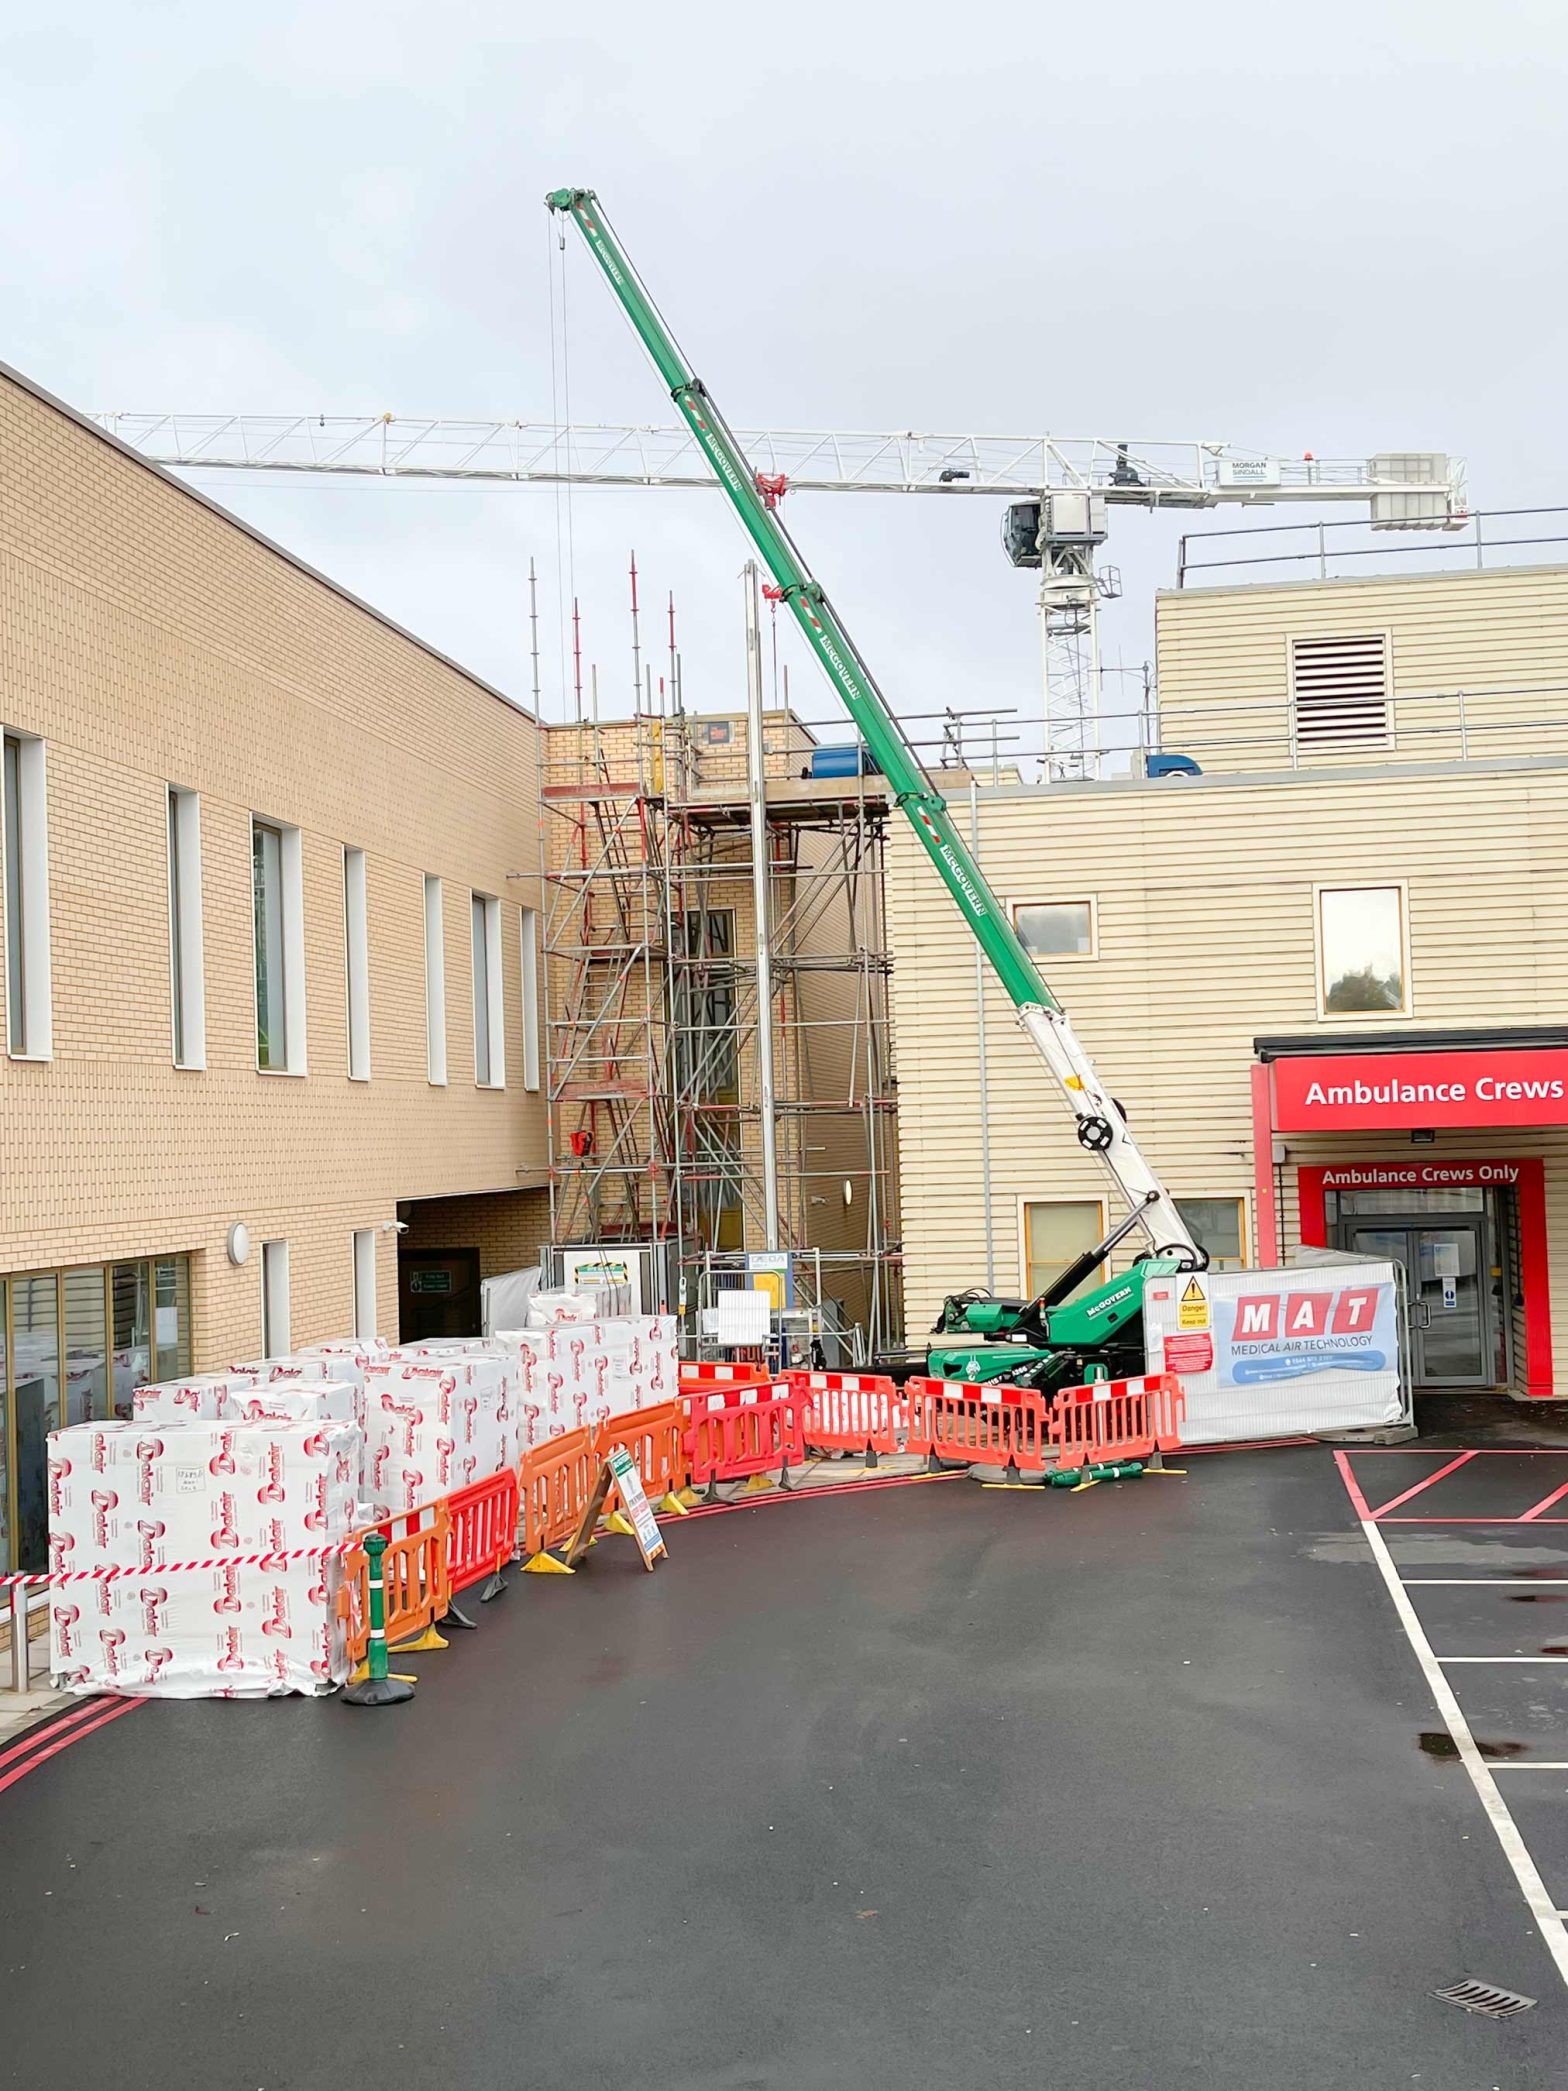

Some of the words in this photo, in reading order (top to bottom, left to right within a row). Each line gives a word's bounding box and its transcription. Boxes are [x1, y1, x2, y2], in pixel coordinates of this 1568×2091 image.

[940, 844, 988, 917] McGOVERN
[1304, 1079, 1466, 1105] Ambulance
[1475, 1077, 1565, 1101] Crews
[1322, 1168, 1417, 1185] Ambulance
[1422, 1167, 1474, 1182] Crews
[1478, 1164, 1520, 1183] Only
[1181, 1304, 1206, 1312] Danger
[1231, 1343, 1281, 1356] MEDICAL
[1283, 1341, 1302, 1351] AIR
[1304, 1335, 1374, 1350] TECHNOLOGY
[94, 1433, 106, 1474] alair
[138, 1439, 162, 1505] Dalair
[259, 1441, 285, 1504] Dalair
[91, 1490, 116, 1548] Dalair
[212, 1491, 239, 1549] Dalair
